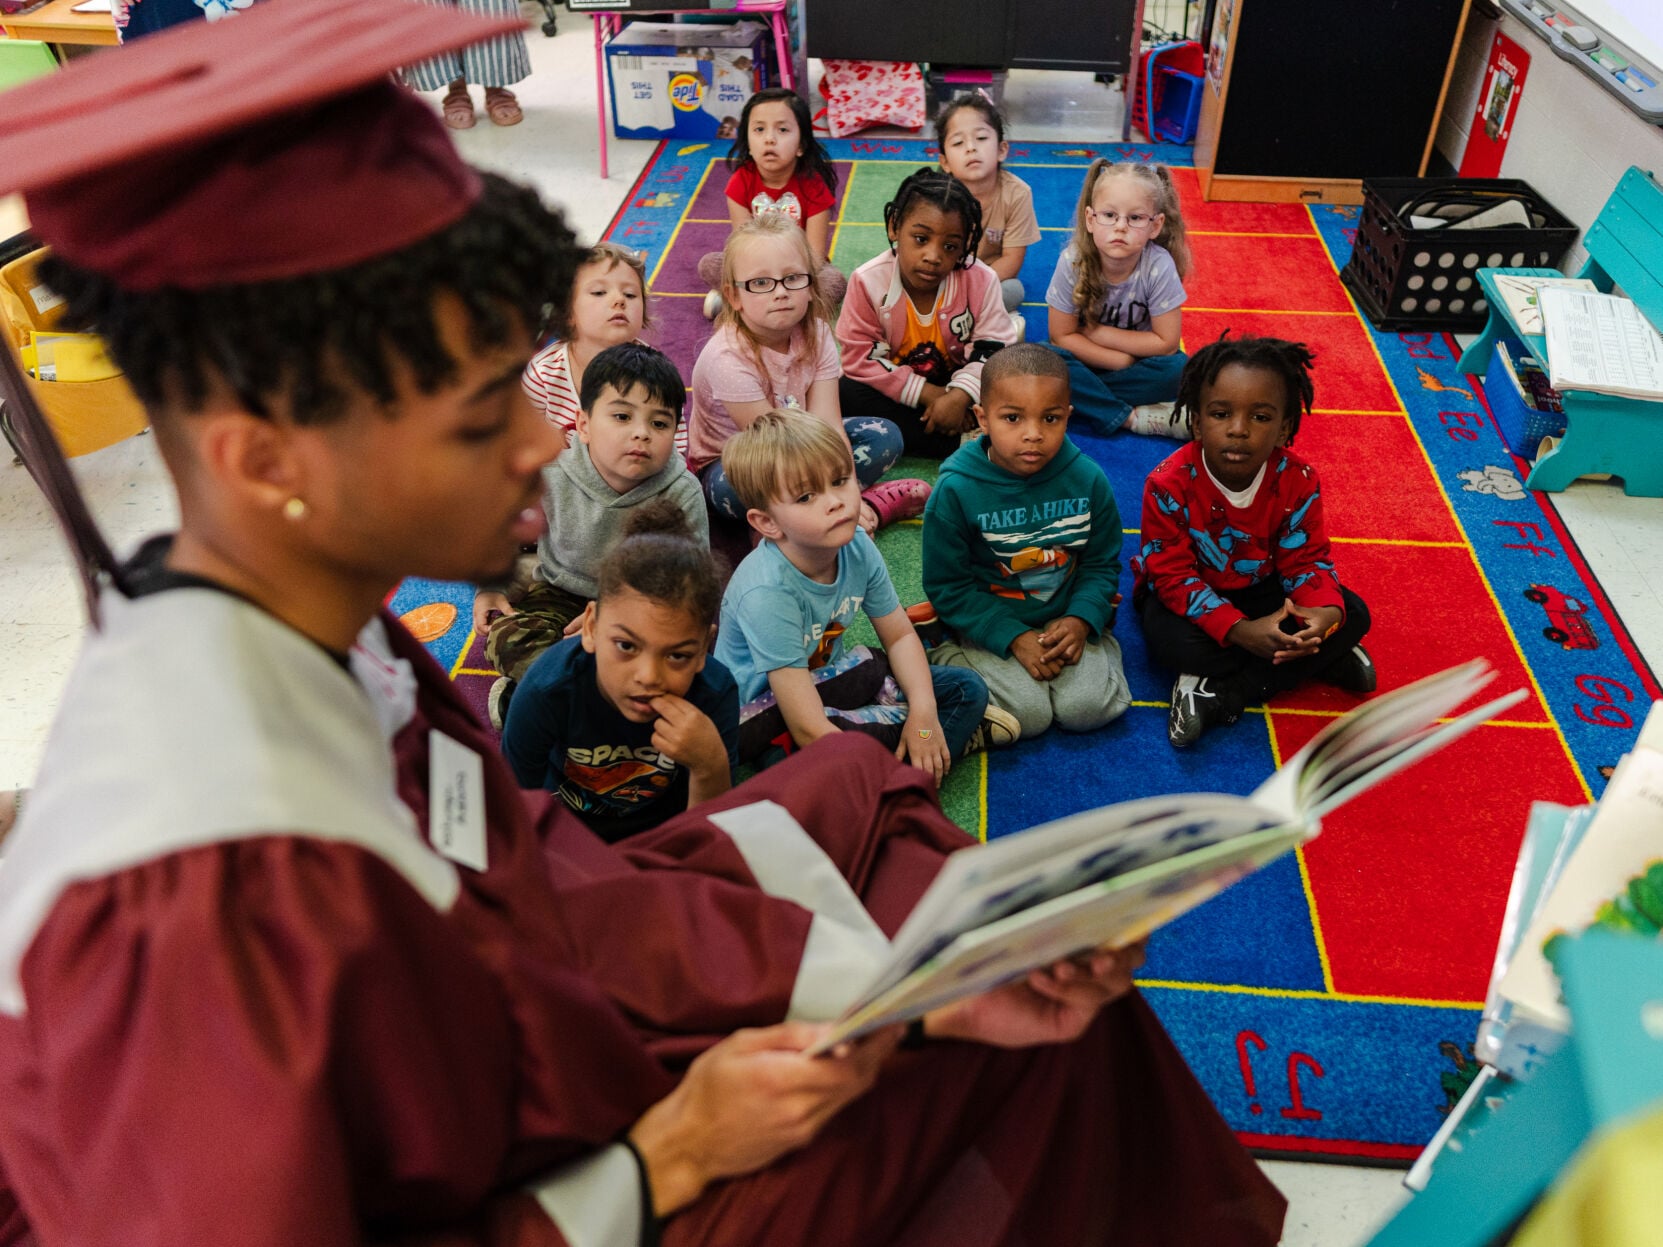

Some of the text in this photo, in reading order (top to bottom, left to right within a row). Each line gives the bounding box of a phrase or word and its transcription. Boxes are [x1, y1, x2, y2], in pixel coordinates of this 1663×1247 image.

[630, 81, 653, 91] THIS
[633, 91, 653, 100] GET
[673, 81, 700, 102] Tide
[718, 93, 745, 102] LOAD
[719, 83, 743, 93] THIS
[1438, 411, 1484, 442] Ee
[977, 497, 1090, 531] TAKE A HIKE
[1492, 519, 1556, 558] Ff
[1574, 674, 1635, 729] Gg
[567, 744, 676, 770] SPACE
